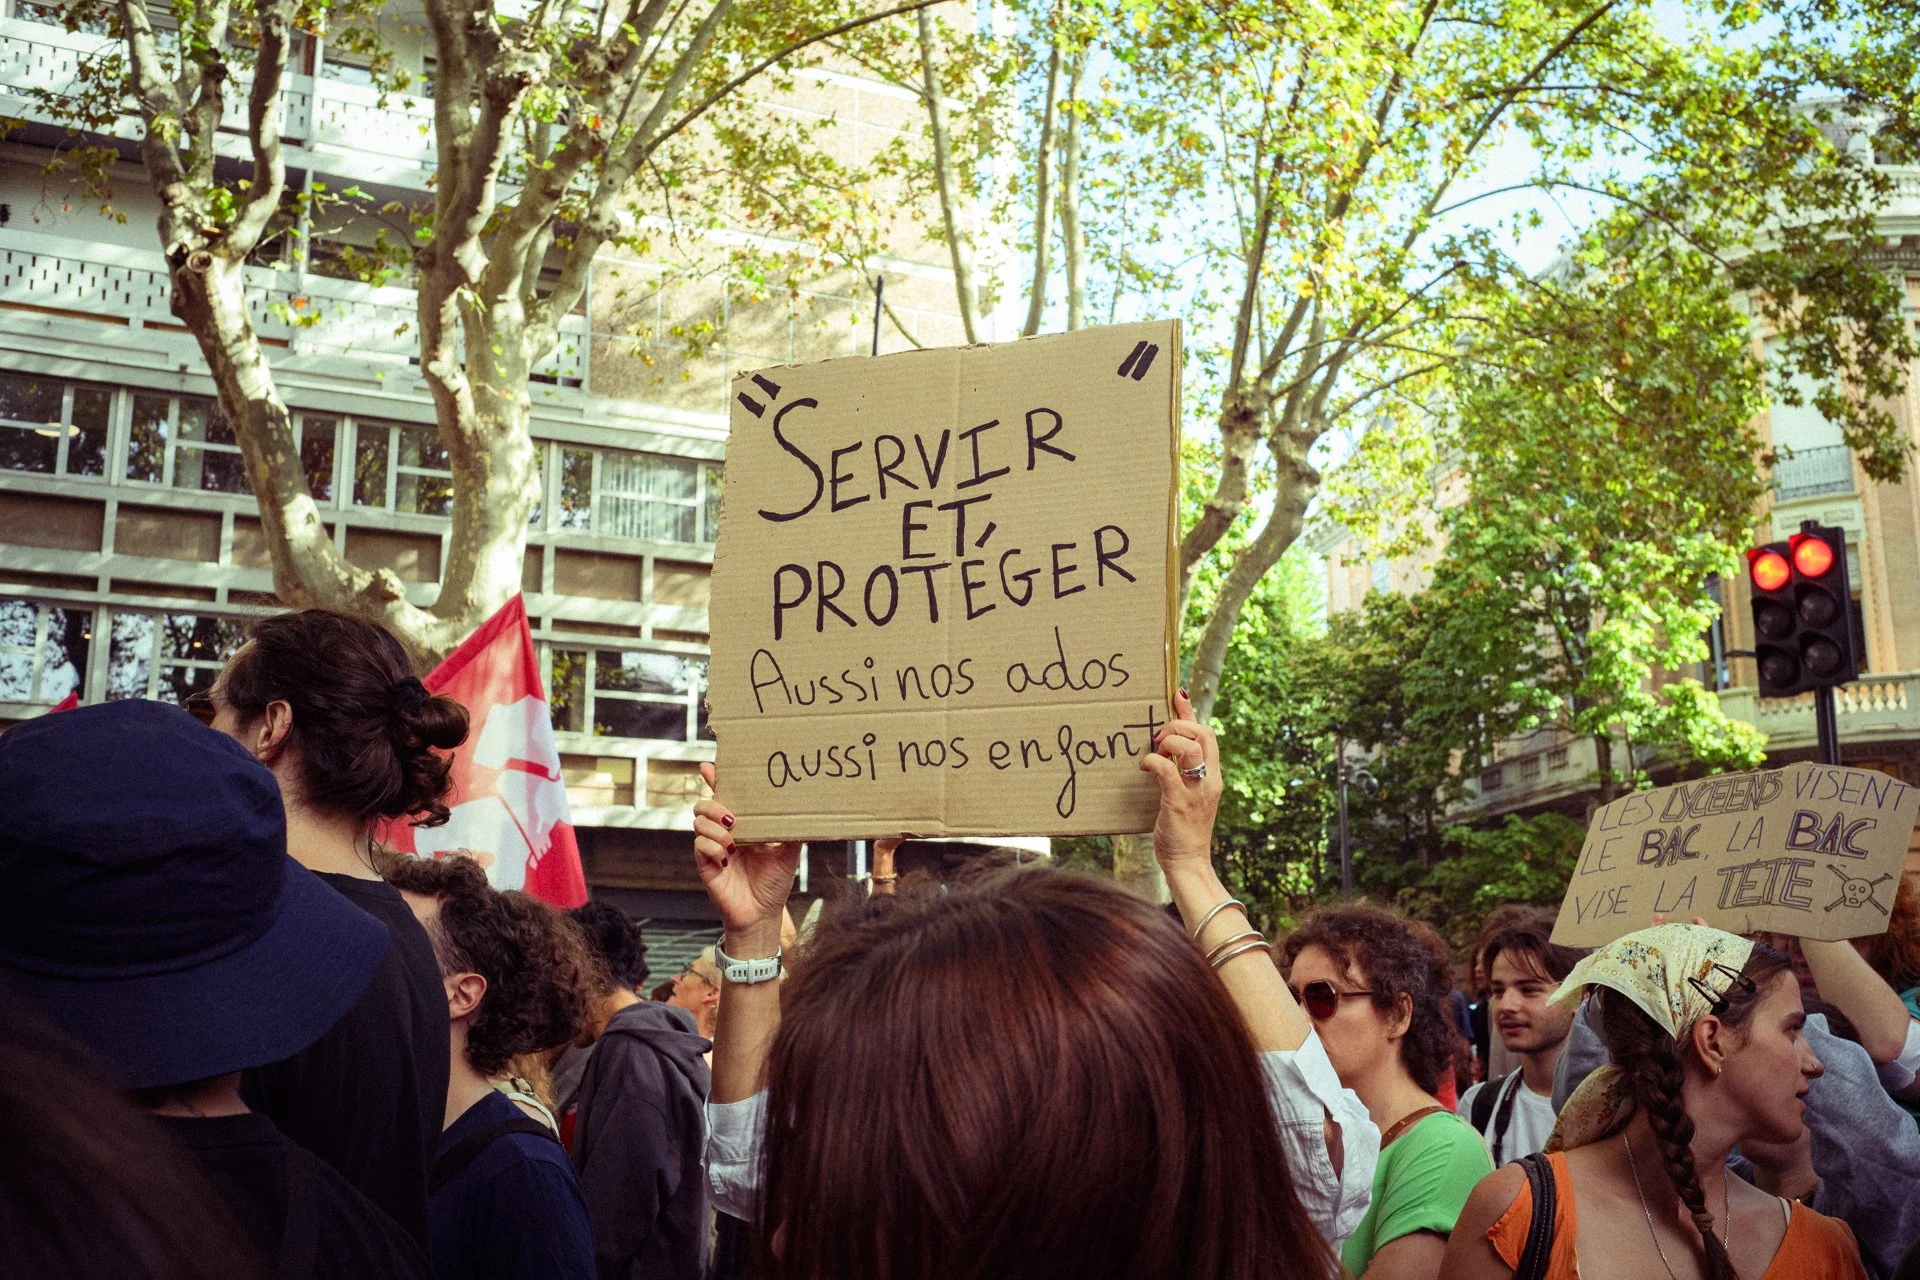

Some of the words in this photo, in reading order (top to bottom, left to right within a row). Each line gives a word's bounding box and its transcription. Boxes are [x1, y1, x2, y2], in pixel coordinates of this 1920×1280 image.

[902, 493, 993, 560] ET
[773, 521, 1137, 641] PROTÉGER
[750, 648, 878, 713] Aussi
[896, 659, 974, 700] nos
[1006, 626, 1130, 692] ados
[767, 733, 877, 788] aussi
[899, 736, 968, 770] nos
[1599, 791, 1657, 831] LES
[1796, 768, 1910, 811] VISENT
[1580, 836, 1623, 876] LE
[1726, 816, 1764, 852] LA
[1785, 810, 1877, 859] BAC
[1653, 875, 1697, 913] LA
